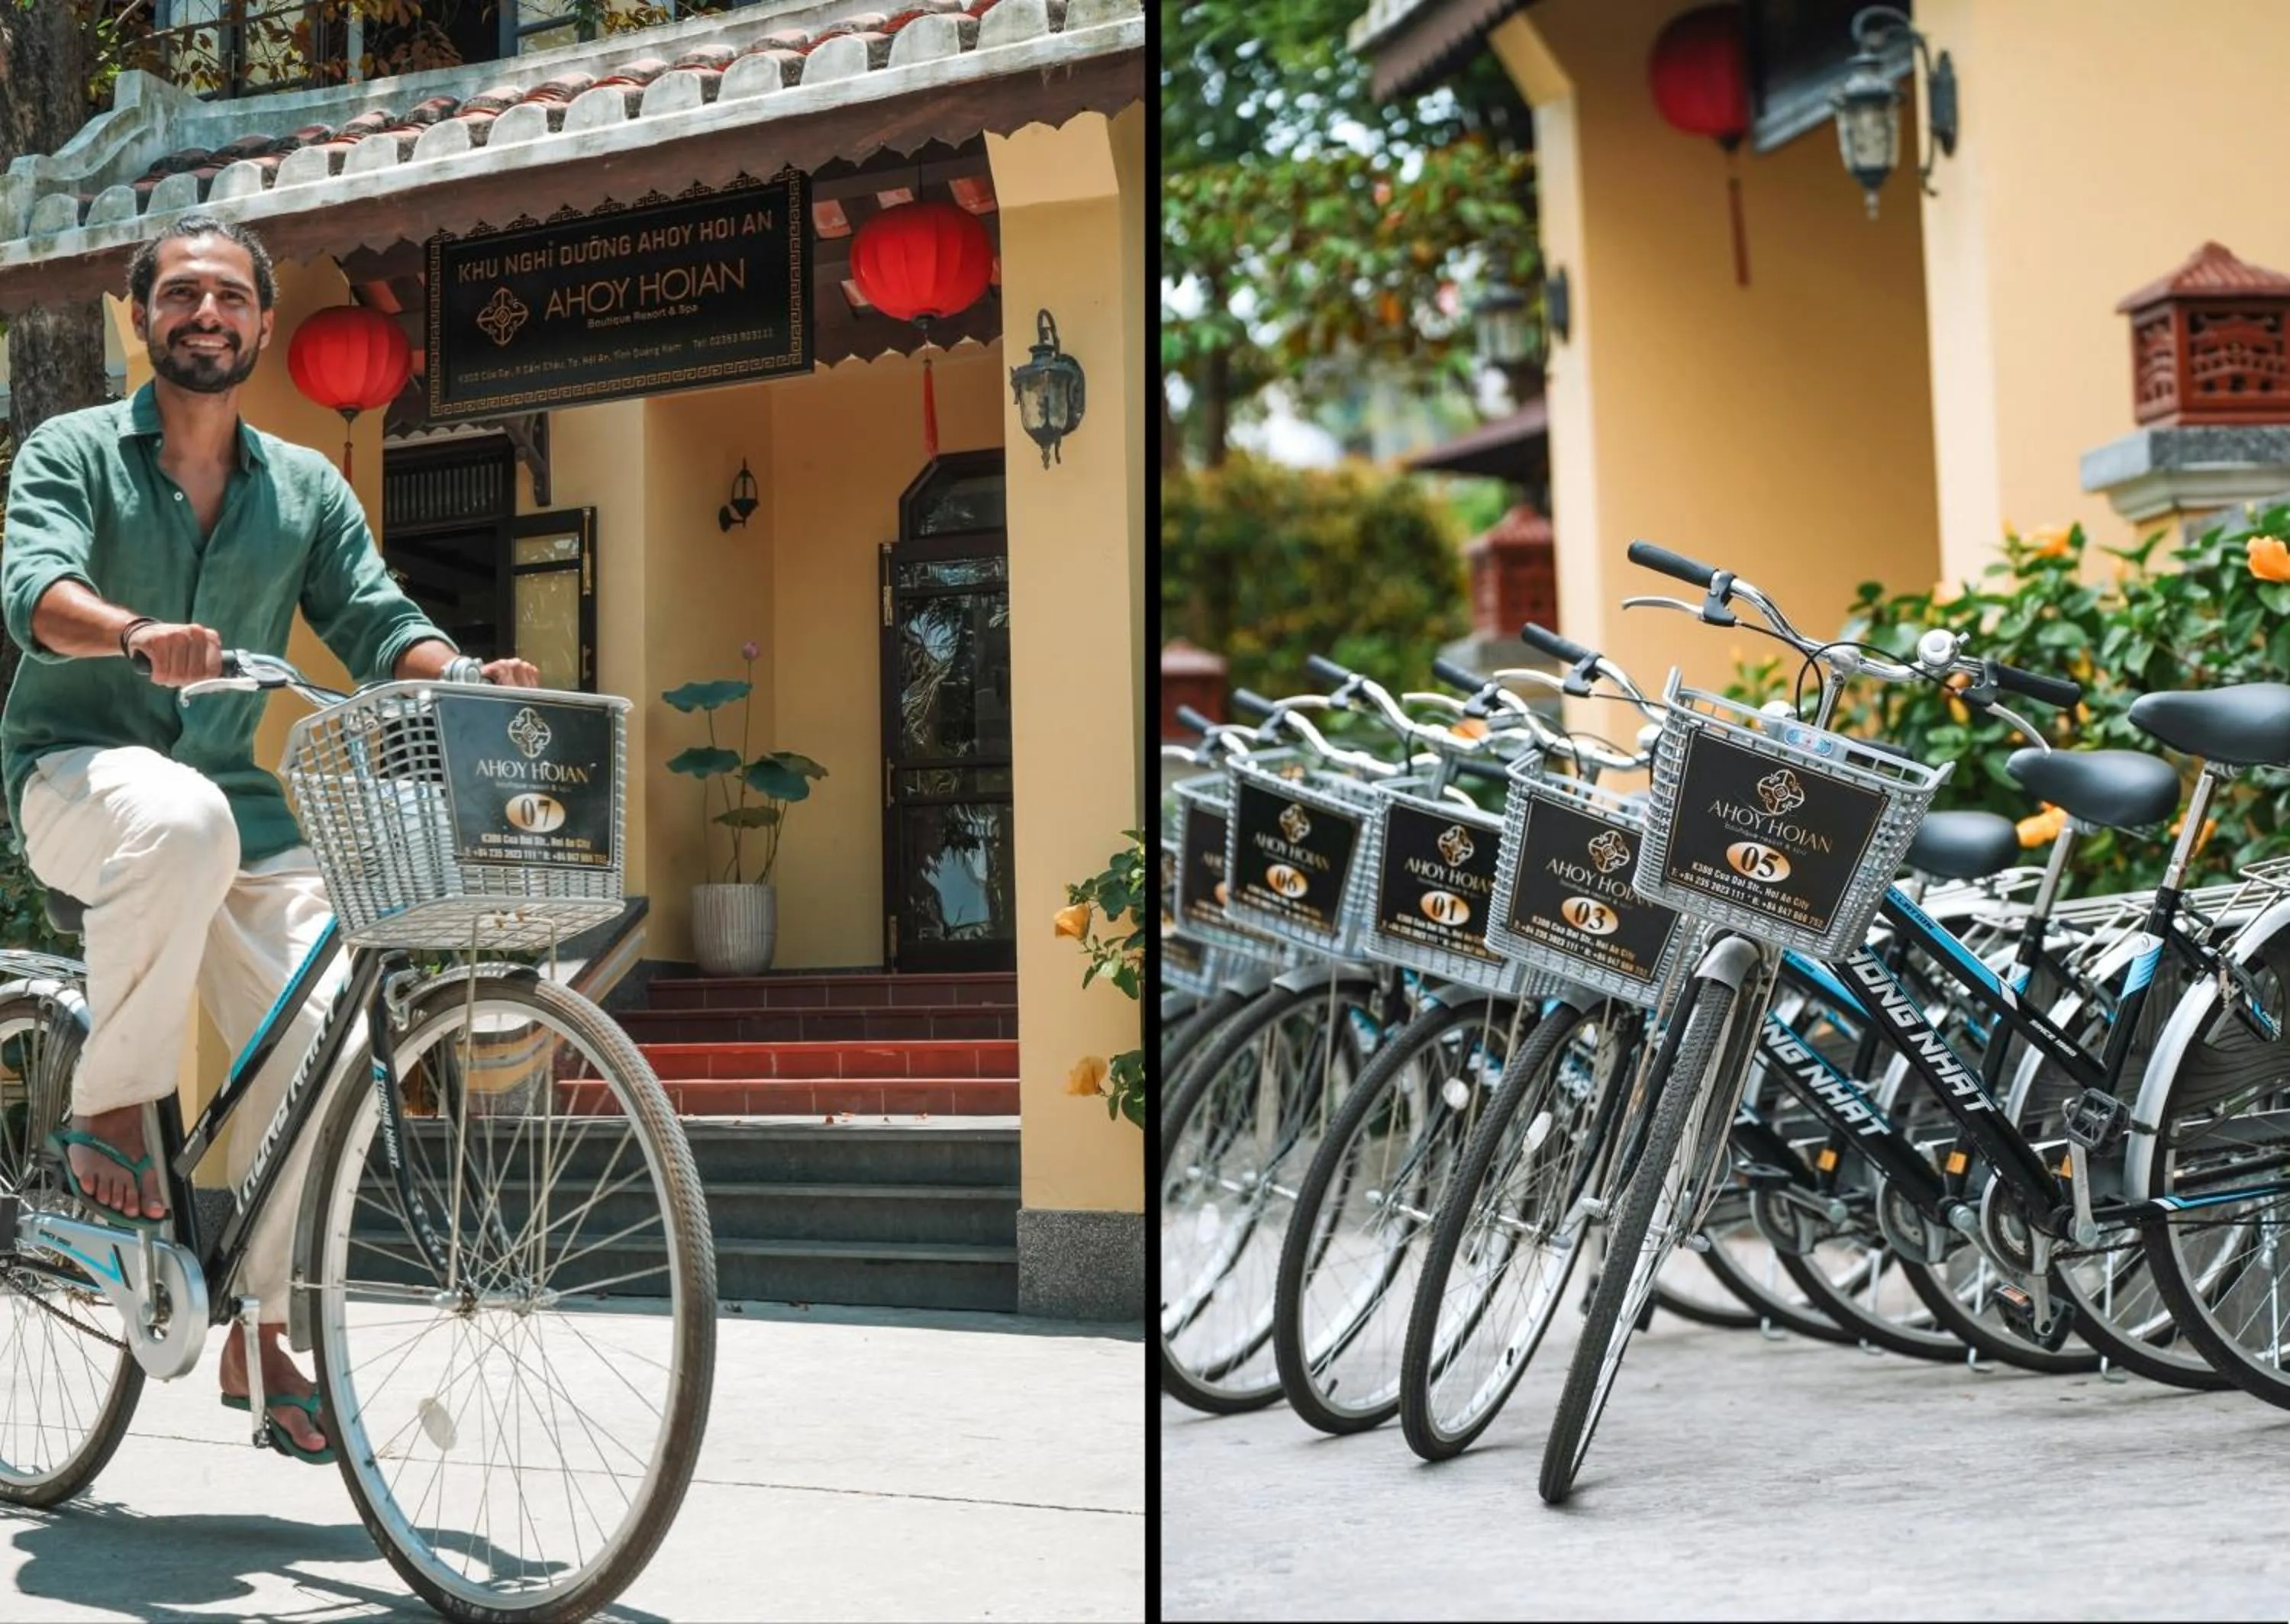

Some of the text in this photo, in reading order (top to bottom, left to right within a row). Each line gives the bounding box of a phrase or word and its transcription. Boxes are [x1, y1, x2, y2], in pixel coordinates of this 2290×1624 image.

[459, 257, 498, 282] KHU
[637, 224, 693, 253] AHOY
[741, 208, 772, 236] AN
[544, 258, 745, 321] AHOY HOIAN
[587, 314, 631, 329] Boutique
[633, 308, 667, 321] Resort
[677, 304, 698, 316] Spa
[476, 759, 589, 785] AHOY HOIAN
[520, 798, 552, 829] 07
[1707, 799, 1832, 855] AHOY HOIAN
[1254, 831, 1289, 857] AHOY
[1405, 857, 1447, 881] AHOY
[1448, 871, 1492, 894] HOIA
[1741, 846, 1781, 878] 05
[1274, 869, 1298, 894] 06
[1545, 858, 1653, 908] AHOY HOI
[1730, 888, 1745, 901] 111
[1431, 894, 1458, 922] 01
[1574, 901, 1606, 930] 03
[1792, 896, 1811, 911] City
[1908, 1030, 1996, 1112] NHAT
[1795, 1064, 1892, 1136] NHAT
